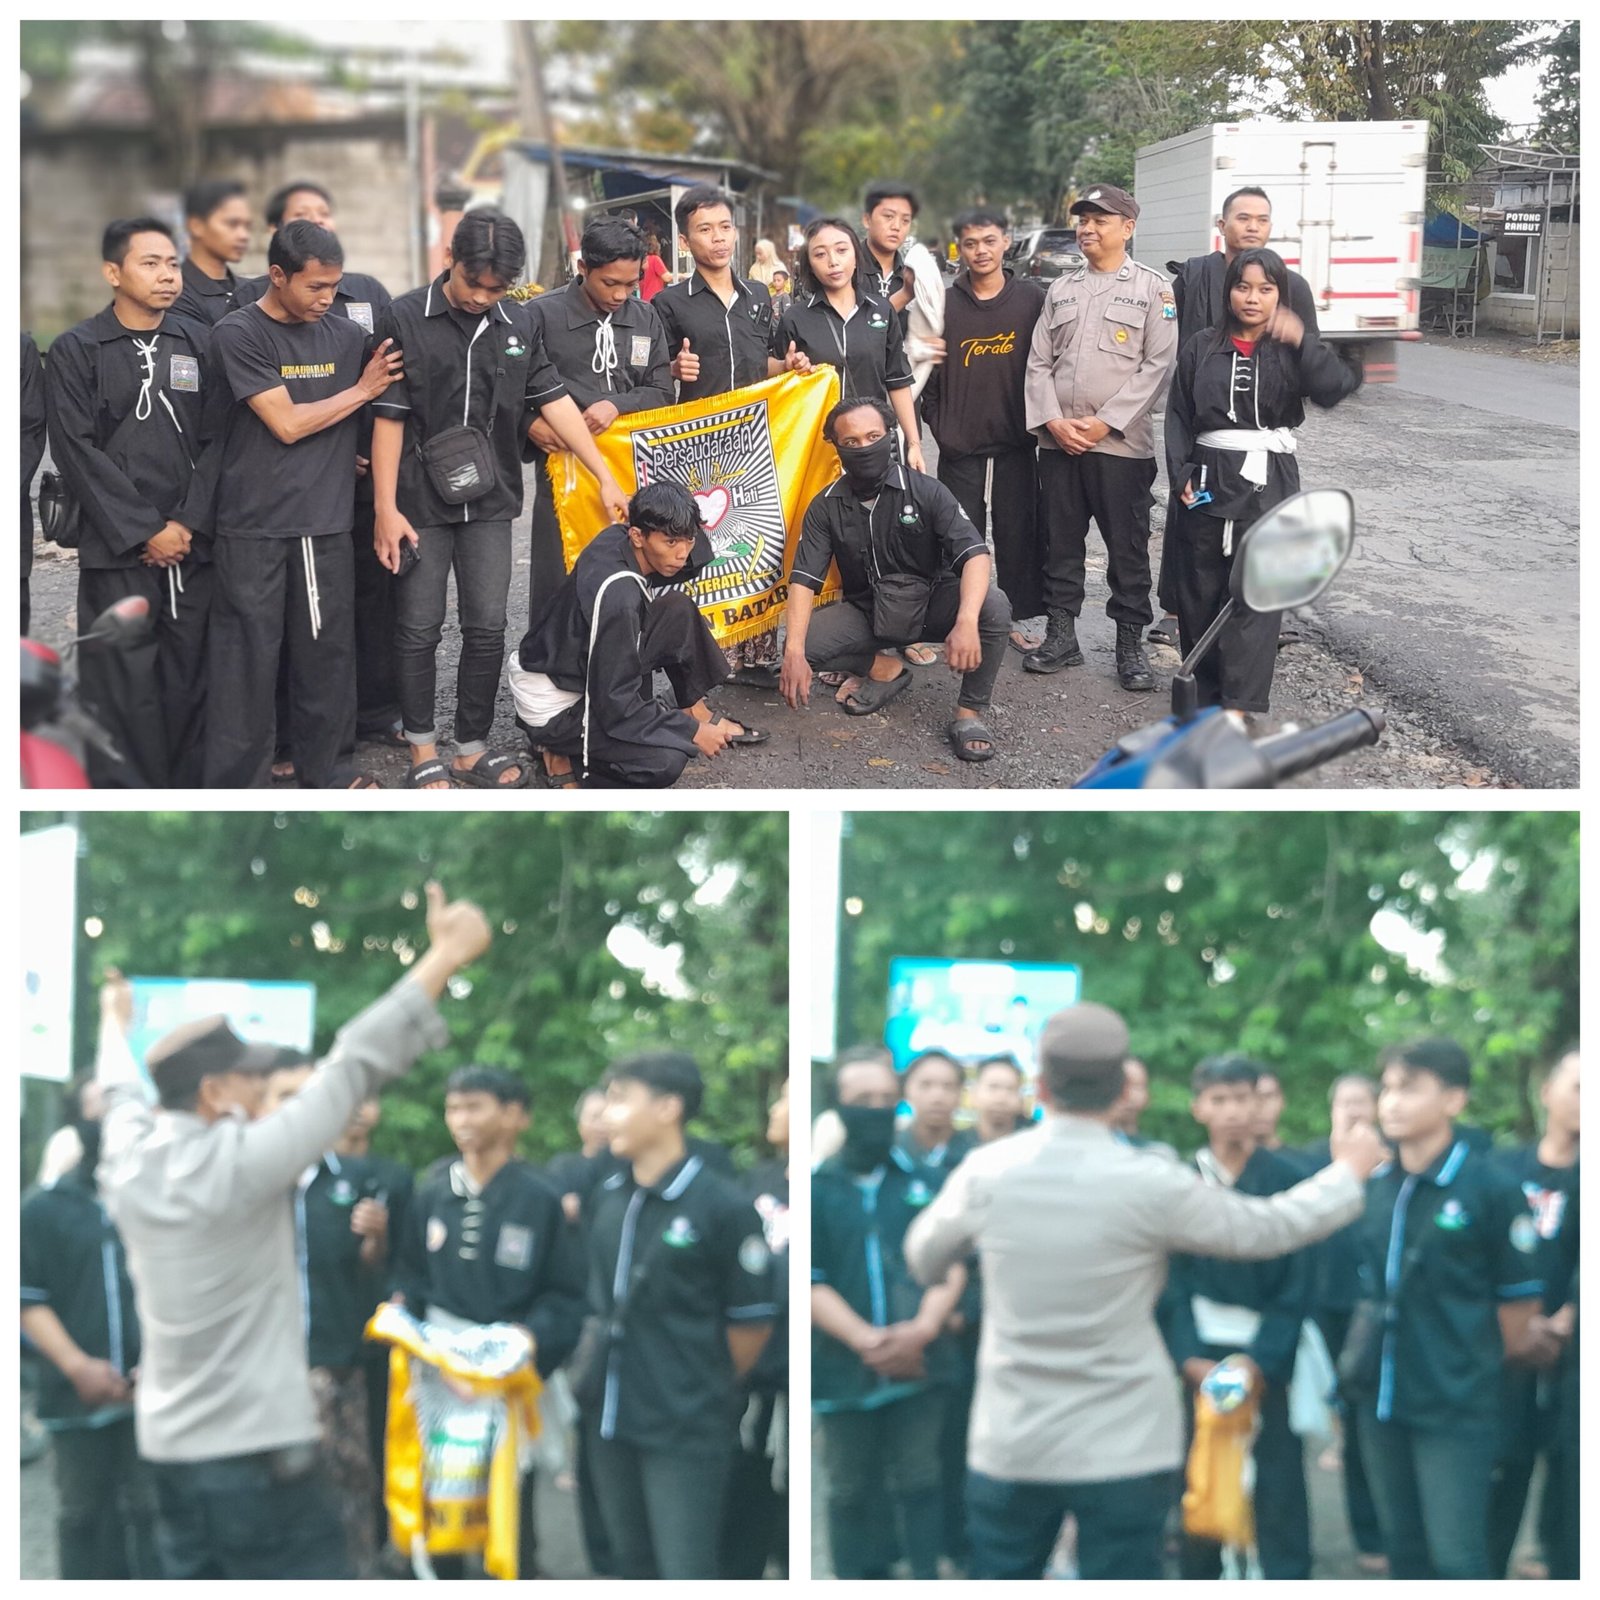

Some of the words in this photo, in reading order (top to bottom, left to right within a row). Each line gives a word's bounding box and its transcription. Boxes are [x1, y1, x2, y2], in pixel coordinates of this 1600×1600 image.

[1504, 222, 1540, 231] RAMBUT
[1113, 296, 1148, 308] POLRI
[960, 331, 1015, 367] Terate
[653, 425, 753, 475] Persaudaraan
[732, 485, 759, 507] Hati
[696, 572, 744, 595] TERATE
